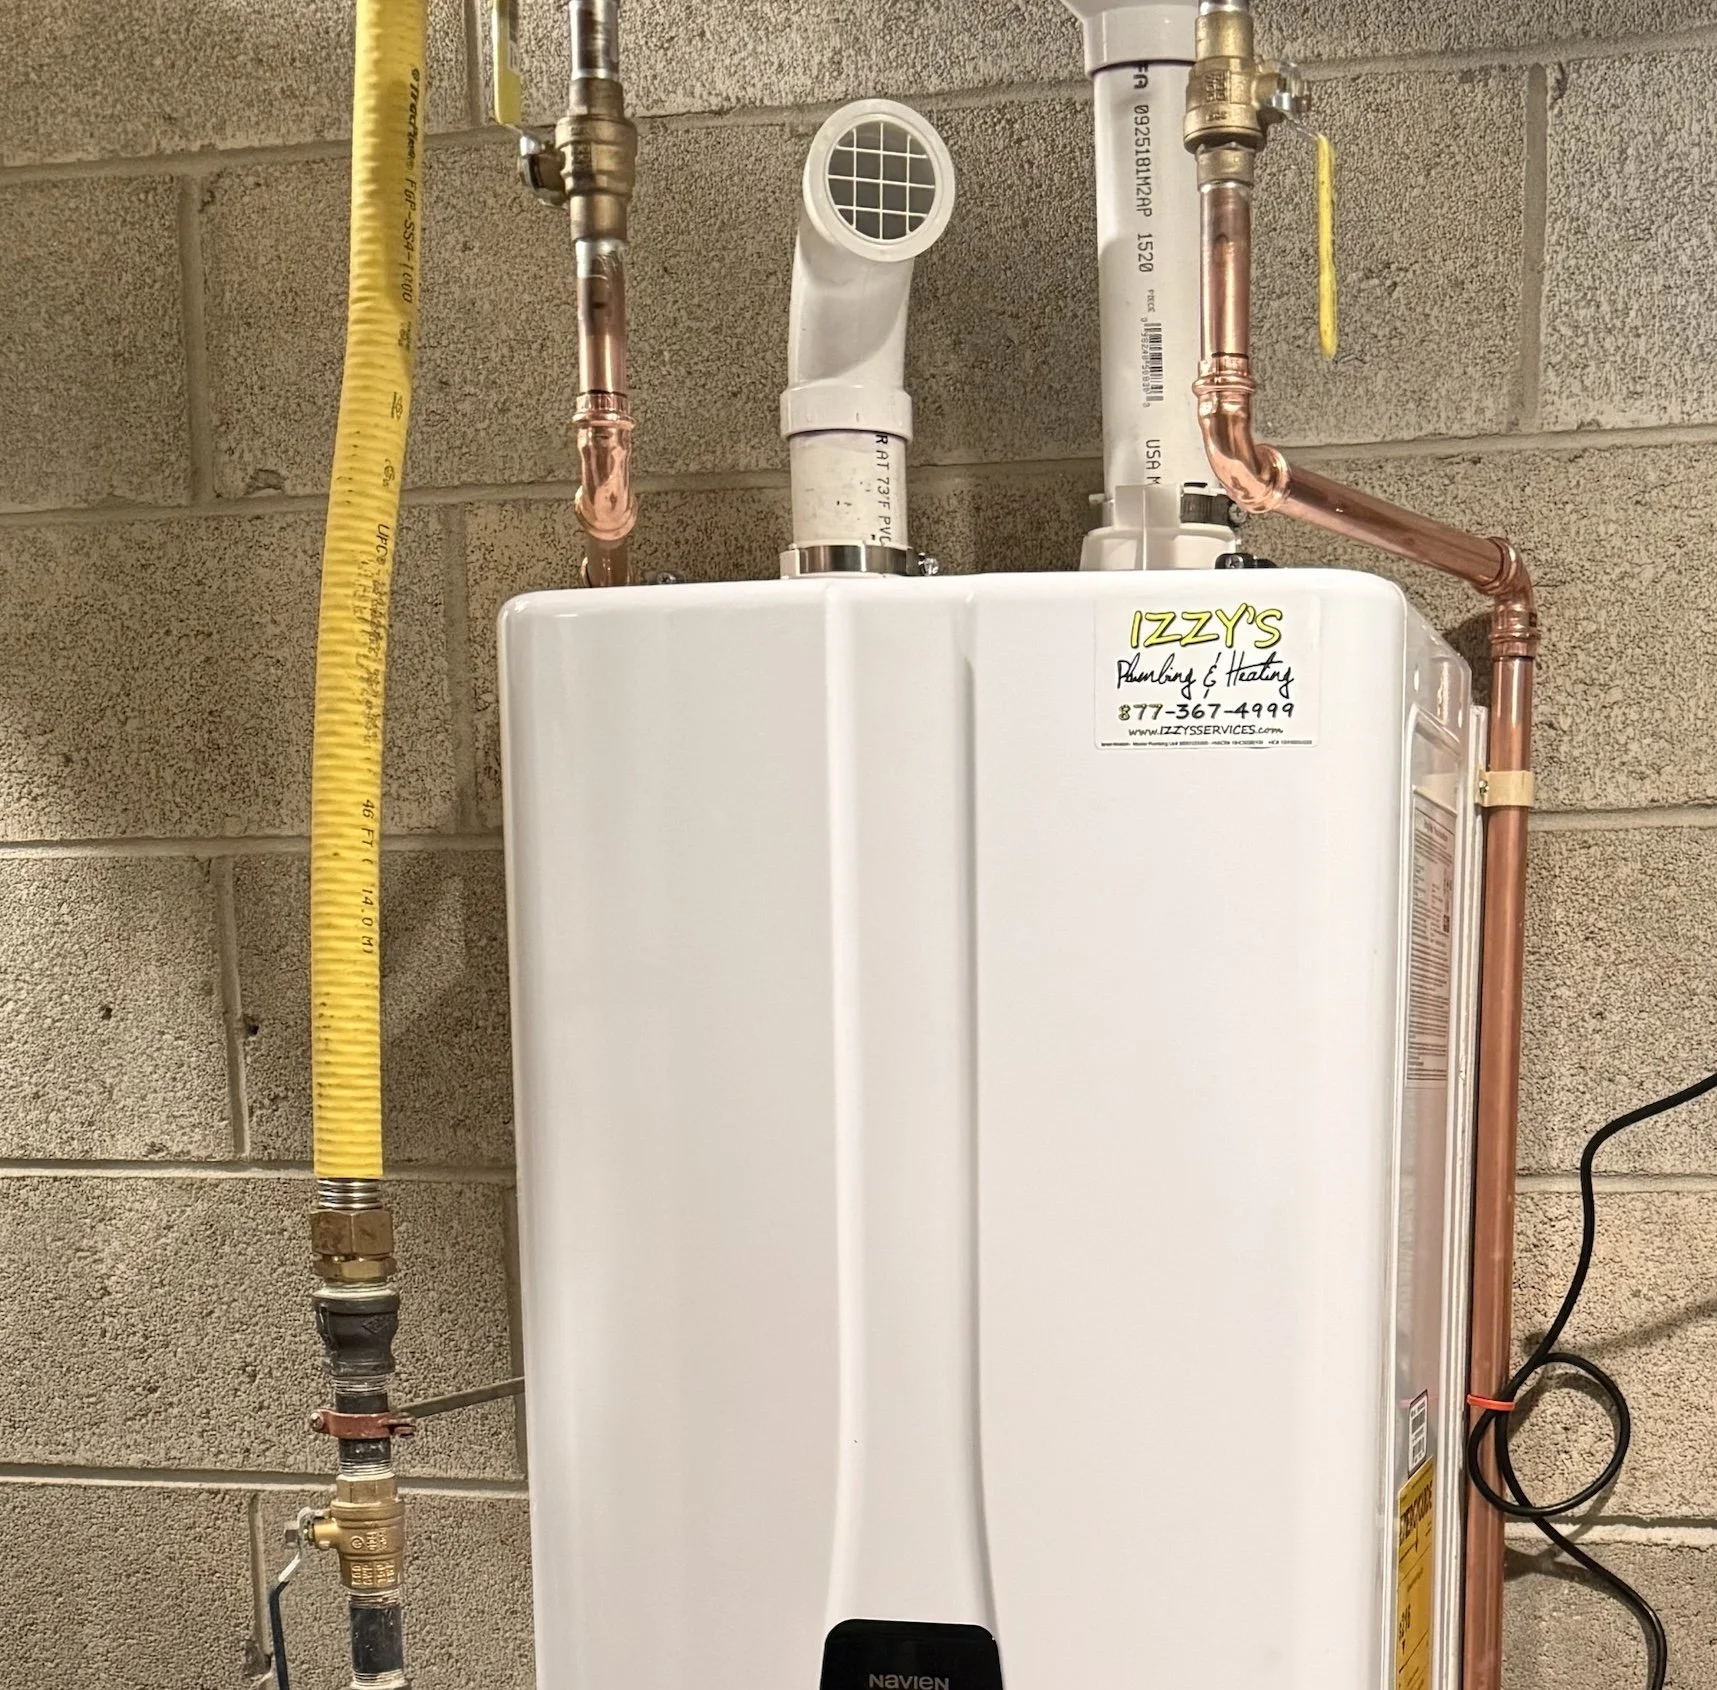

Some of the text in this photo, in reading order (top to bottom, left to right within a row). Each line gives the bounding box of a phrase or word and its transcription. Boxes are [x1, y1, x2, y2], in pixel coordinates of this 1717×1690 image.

[1134, 104, 1153, 217] 0925181M2AP
[1137, 233, 1154, 273] 1520
[876, 450, 889, 471] AT
[1146, 439, 1161, 470] USA
[879, 515, 892, 547] PVC
[1129, 602, 1284, 650] IZZY'S
[1116, 649, 1295, 701] Plumbing & Heating
[1117, 702, 1296, 722] 877-367-4999
[1128, 724, 1284, 738] www.IZZYSSERVICES.com
[362, 798, 375, 820] 46
[361, 828, 375, 848] FT
